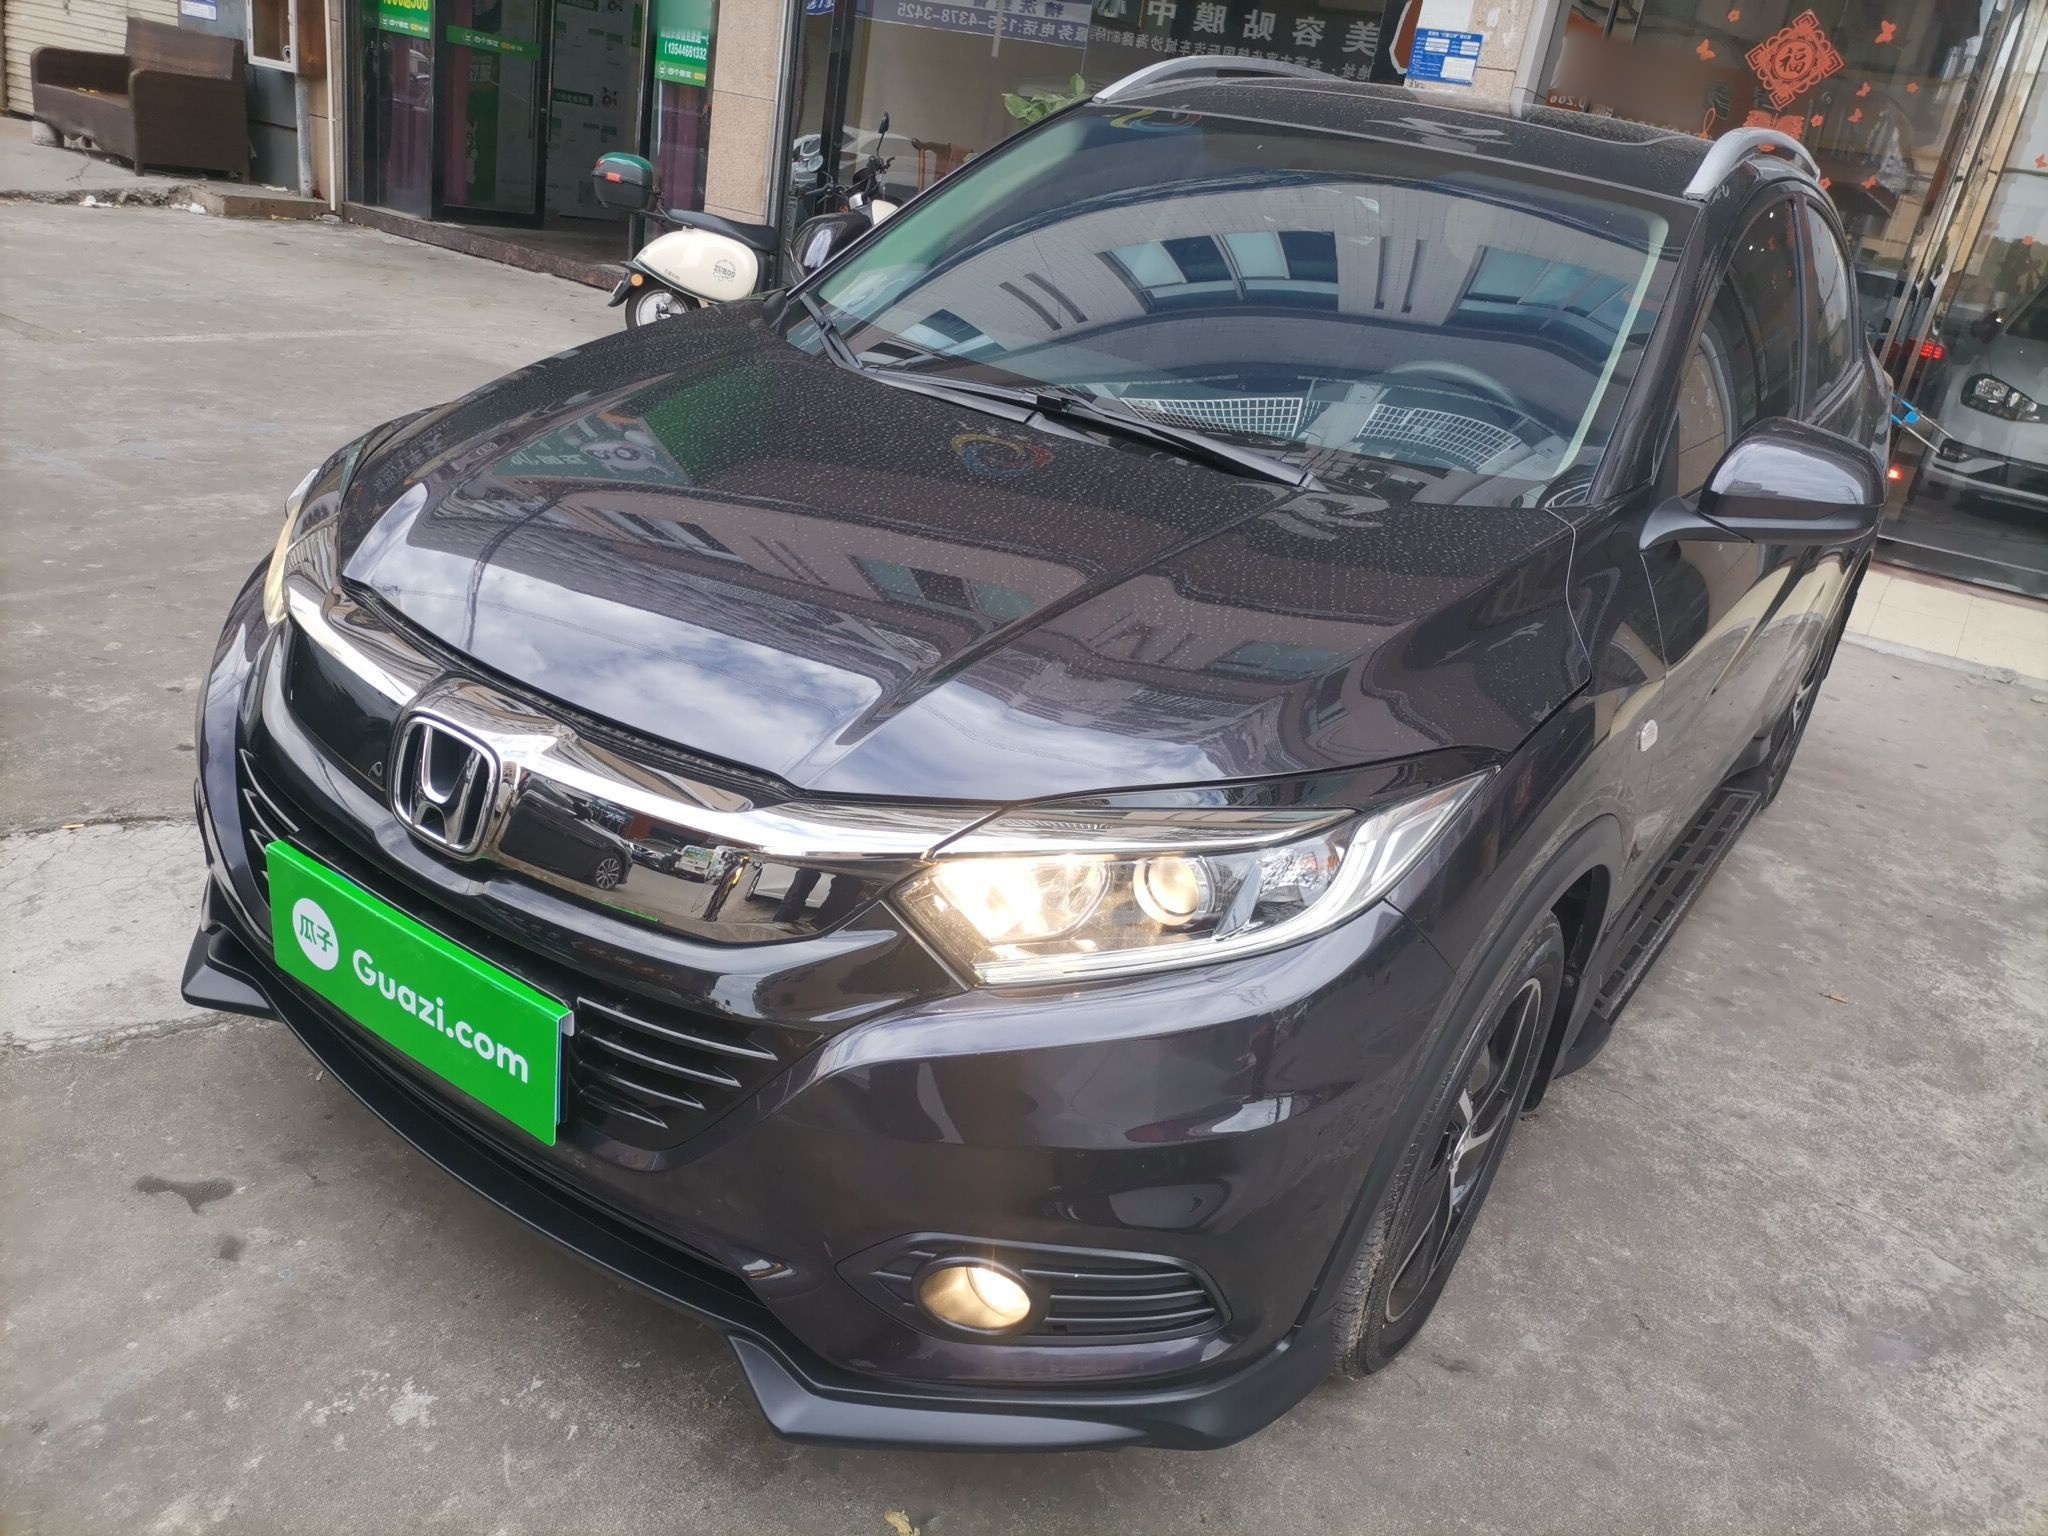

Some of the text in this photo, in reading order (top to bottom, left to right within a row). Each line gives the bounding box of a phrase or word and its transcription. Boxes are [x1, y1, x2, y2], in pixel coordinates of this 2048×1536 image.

[1779, 47, 1807, 73] 福
[299, 912, 334, 952] 瓜子
[353, 949, 528, 1084] Guazi.com
